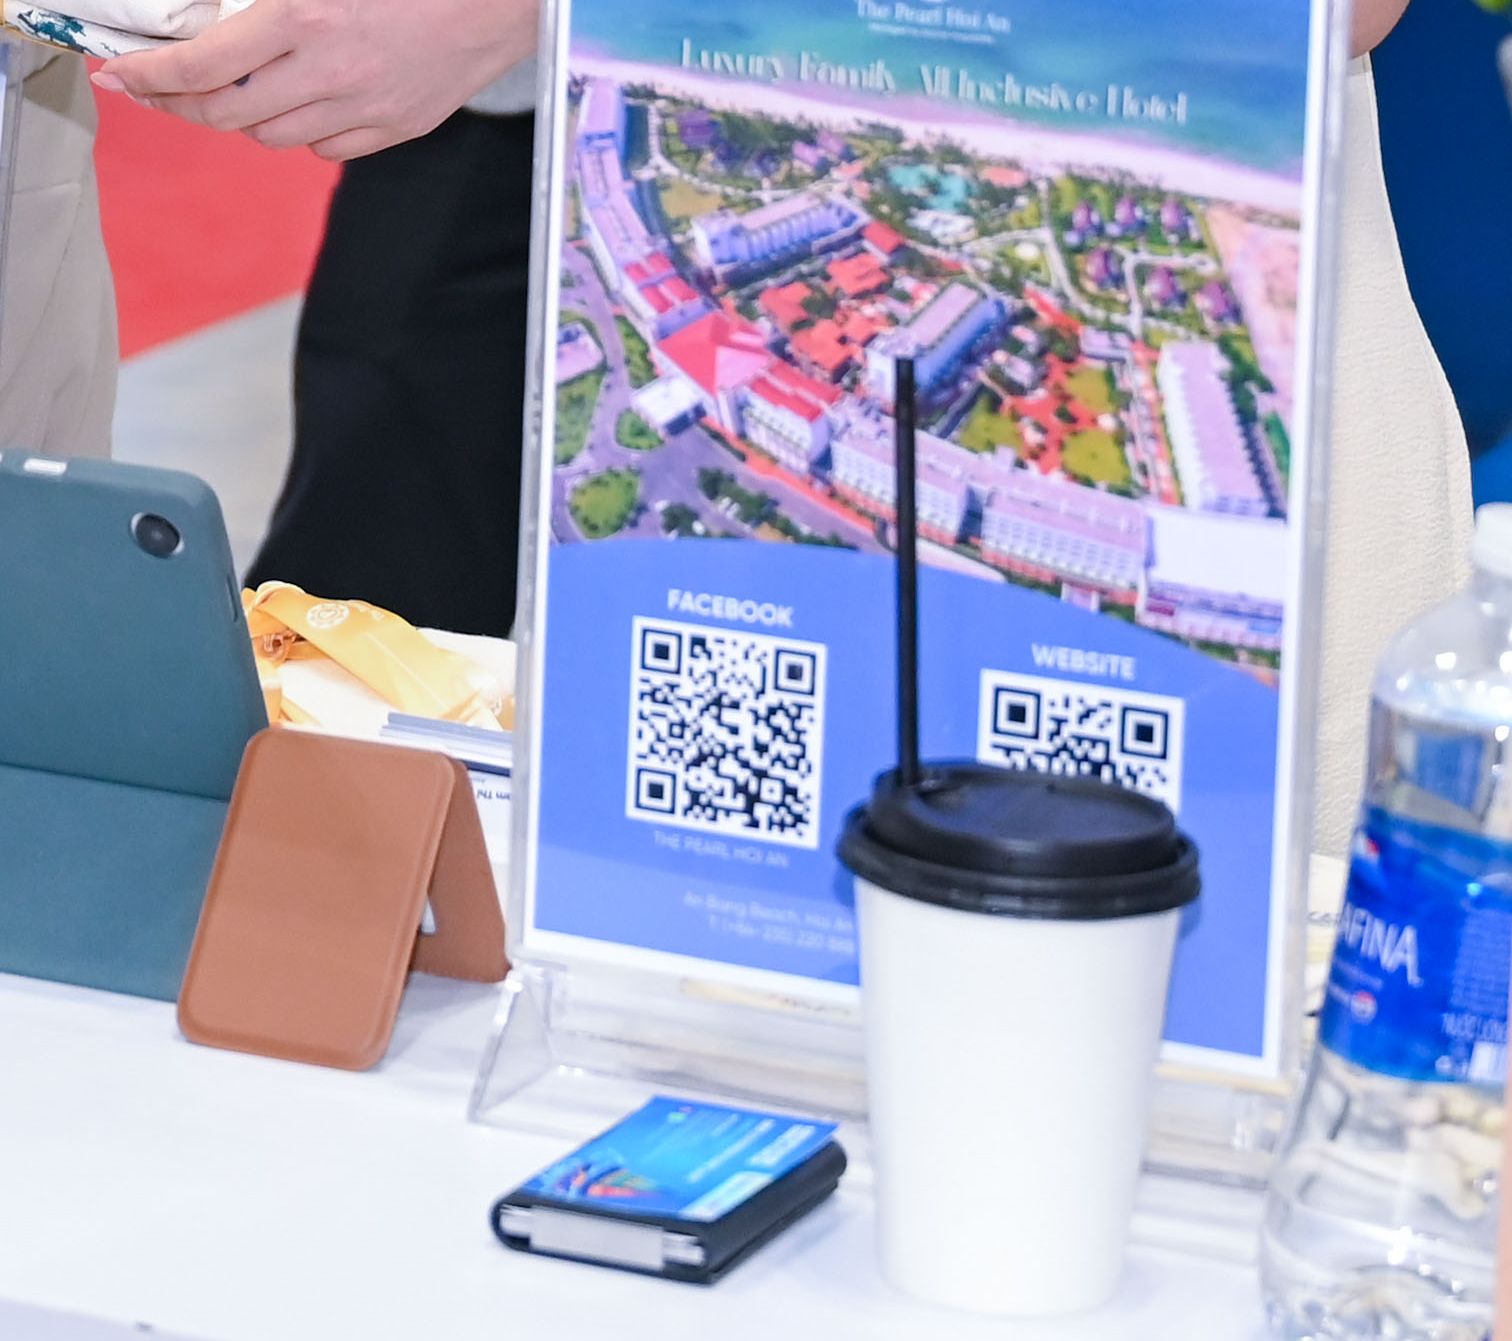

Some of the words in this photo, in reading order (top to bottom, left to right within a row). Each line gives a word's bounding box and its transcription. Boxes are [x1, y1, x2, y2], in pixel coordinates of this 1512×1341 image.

[681, 37, 784, 80] Luxury
[667, 587, 795, 629] FACEBOOK
[1032, 643, 1137, 682] WEBSITE
[653, 830, 681, 853] THE
